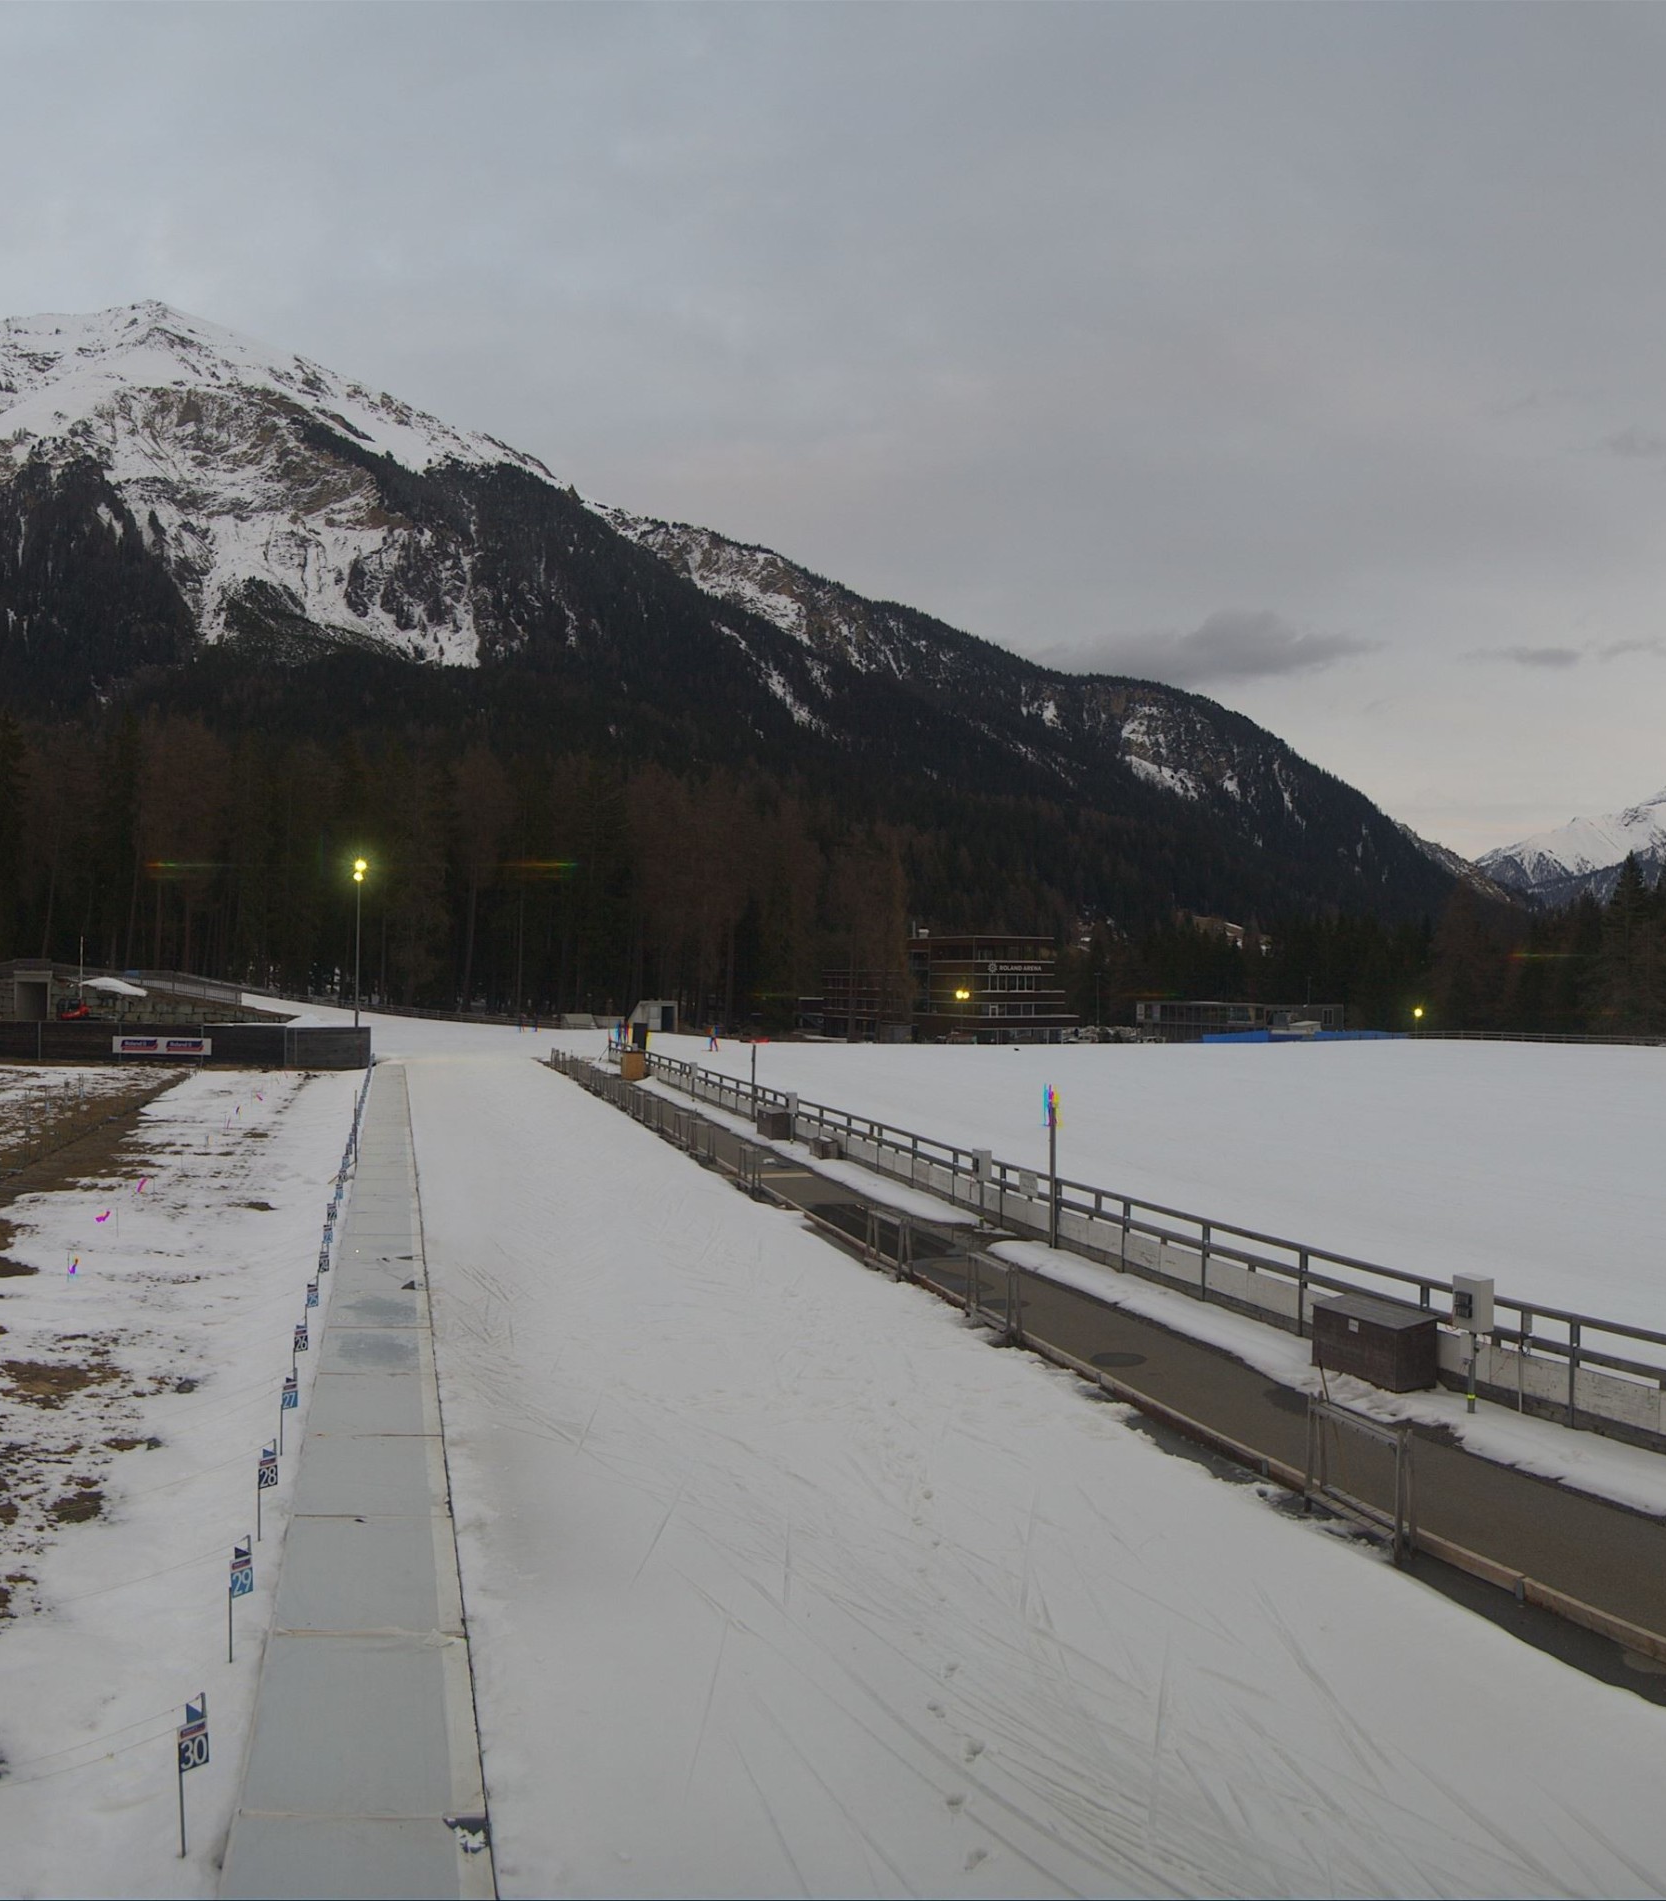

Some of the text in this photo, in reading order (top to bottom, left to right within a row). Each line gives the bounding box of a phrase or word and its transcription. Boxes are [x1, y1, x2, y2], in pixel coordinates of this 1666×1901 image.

[295, 1336, 307, 1351] 26
[283, 1392, 296, 1408] 27
[260, 1467, 277, 1488] 28
[233, 1571, 252, 1597] 29
[181, 1735, 208, 1770] 30
